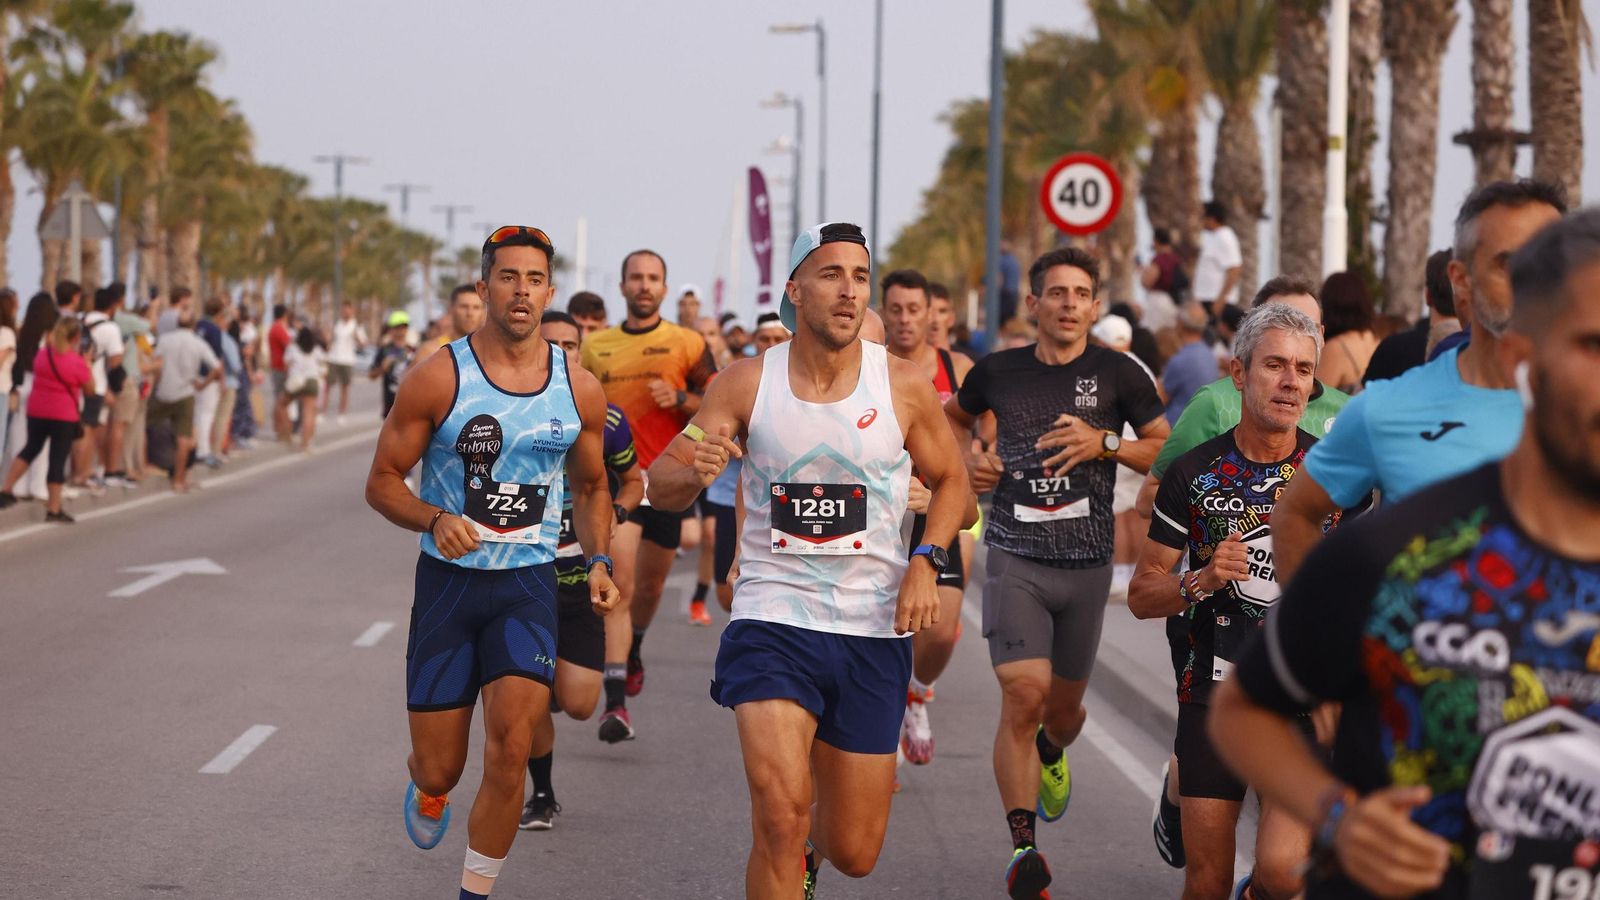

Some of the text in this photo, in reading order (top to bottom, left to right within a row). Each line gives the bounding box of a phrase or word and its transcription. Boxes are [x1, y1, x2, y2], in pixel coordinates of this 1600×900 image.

[1059, 179, 1100, 208] 40
[1075, 396, 1098, 407] OTSO
[457, 440, 501, 454] SENDERO
[470, 463, 490, 478] MAR
[1028, 476, 1070, 493] 1371
[486, 494, 528, 512] 724
[791, 498, 845, 517] 1281
[1528, 864, 1600, 900] 19
